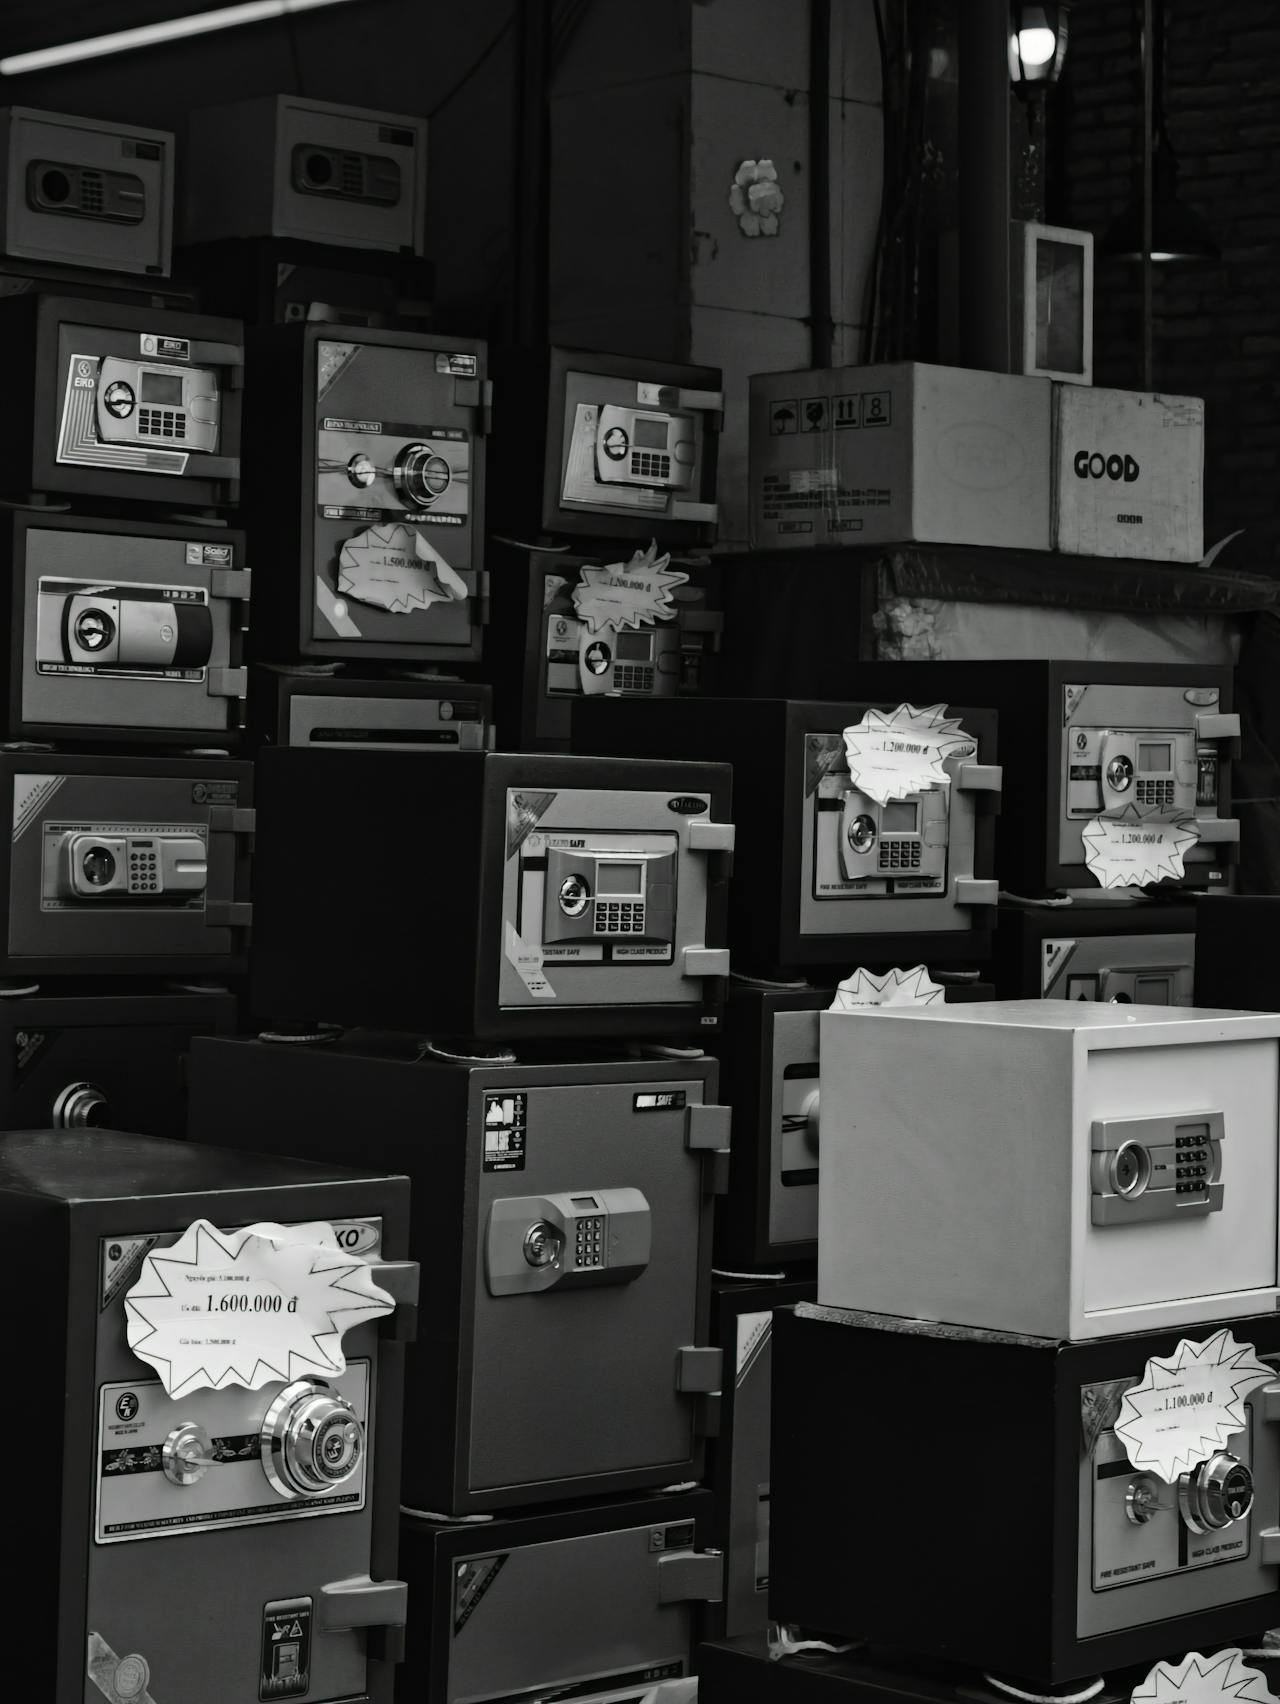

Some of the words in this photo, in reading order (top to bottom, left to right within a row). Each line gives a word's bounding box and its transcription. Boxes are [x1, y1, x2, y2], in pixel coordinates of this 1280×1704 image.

[75, 377, 94, 388] EIKO
[1074, 451, 1140, 482] GOOD
[206, 1294, 282, 1313] 1.600.000
[287, 1295, 299, 1314] đ
[1165, 1392, 1205, 1410] 1.100.000
